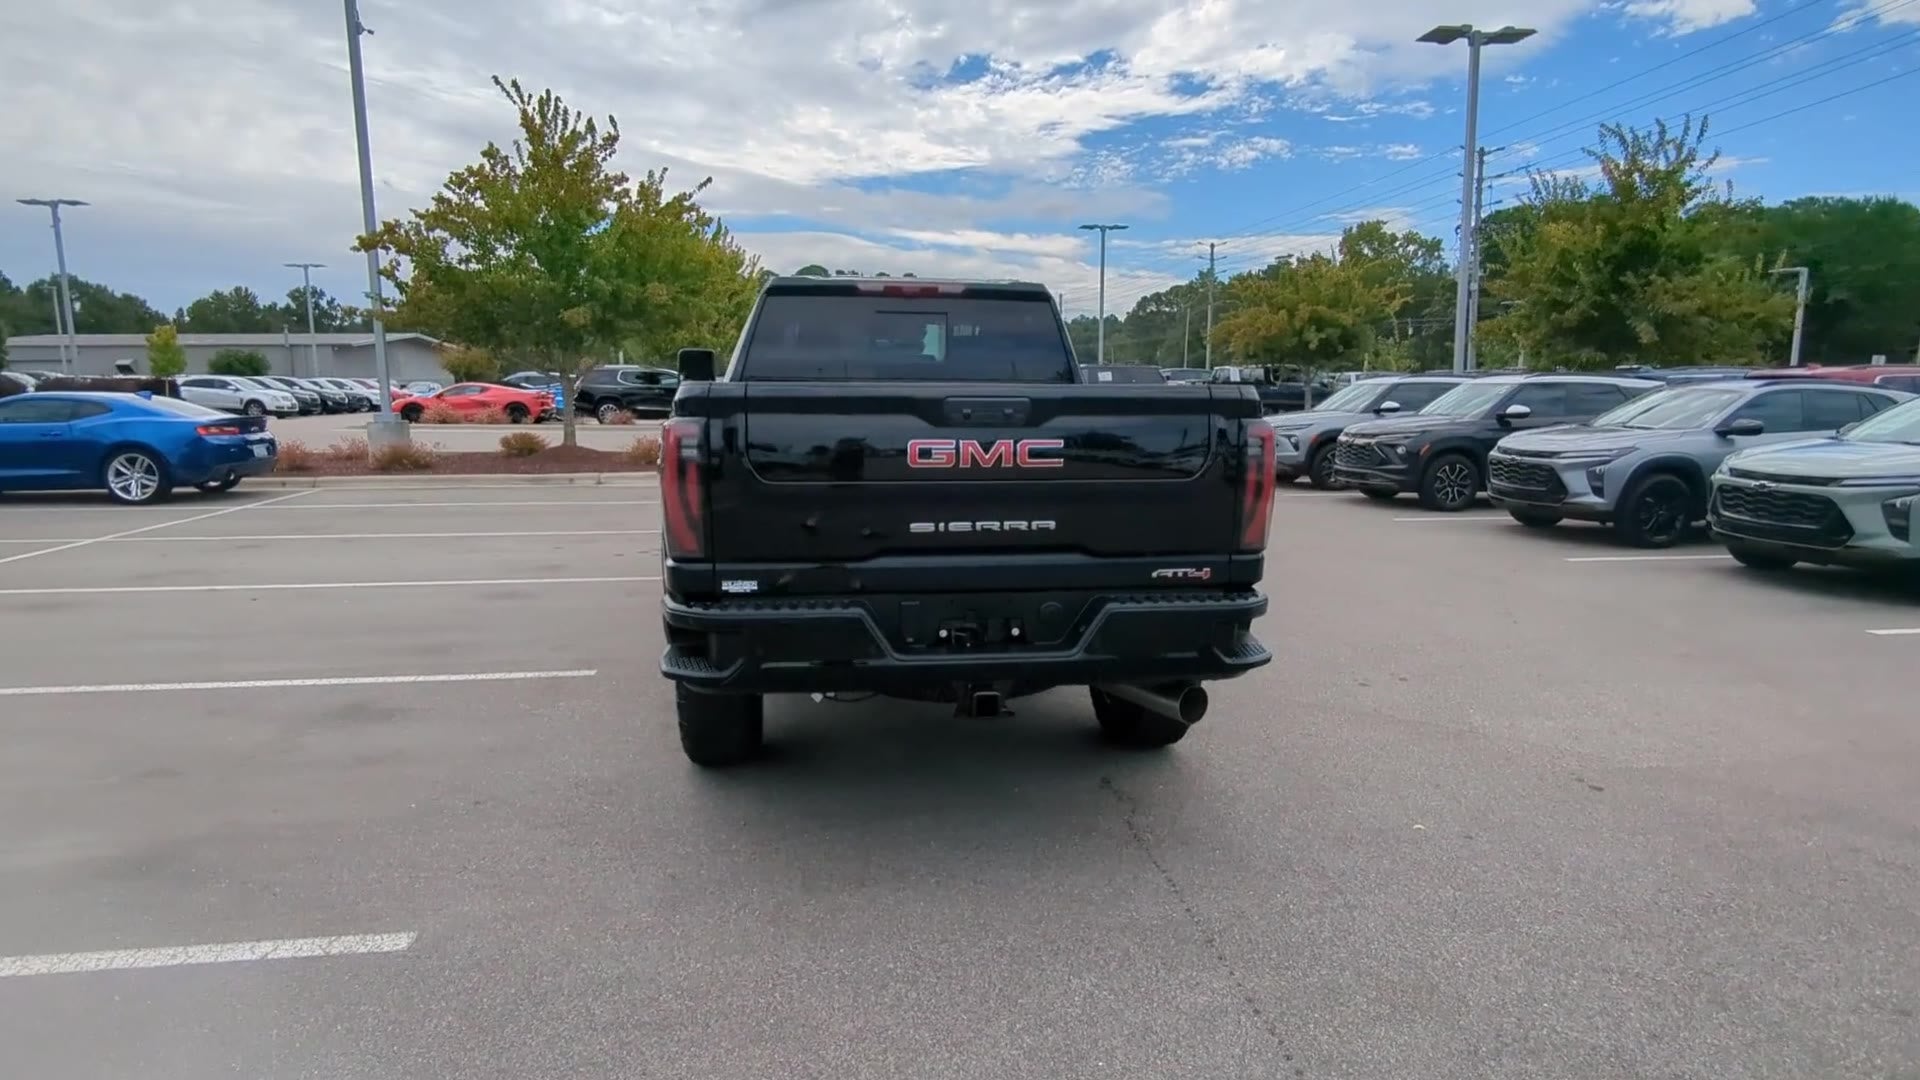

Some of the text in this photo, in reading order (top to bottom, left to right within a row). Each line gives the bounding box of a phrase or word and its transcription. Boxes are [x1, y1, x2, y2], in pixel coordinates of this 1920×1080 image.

[907, 439, 1064, 468] GMC
[909, 520, 1057, 533] SIERRA
[1151, 567, 1211, 580] AT4
